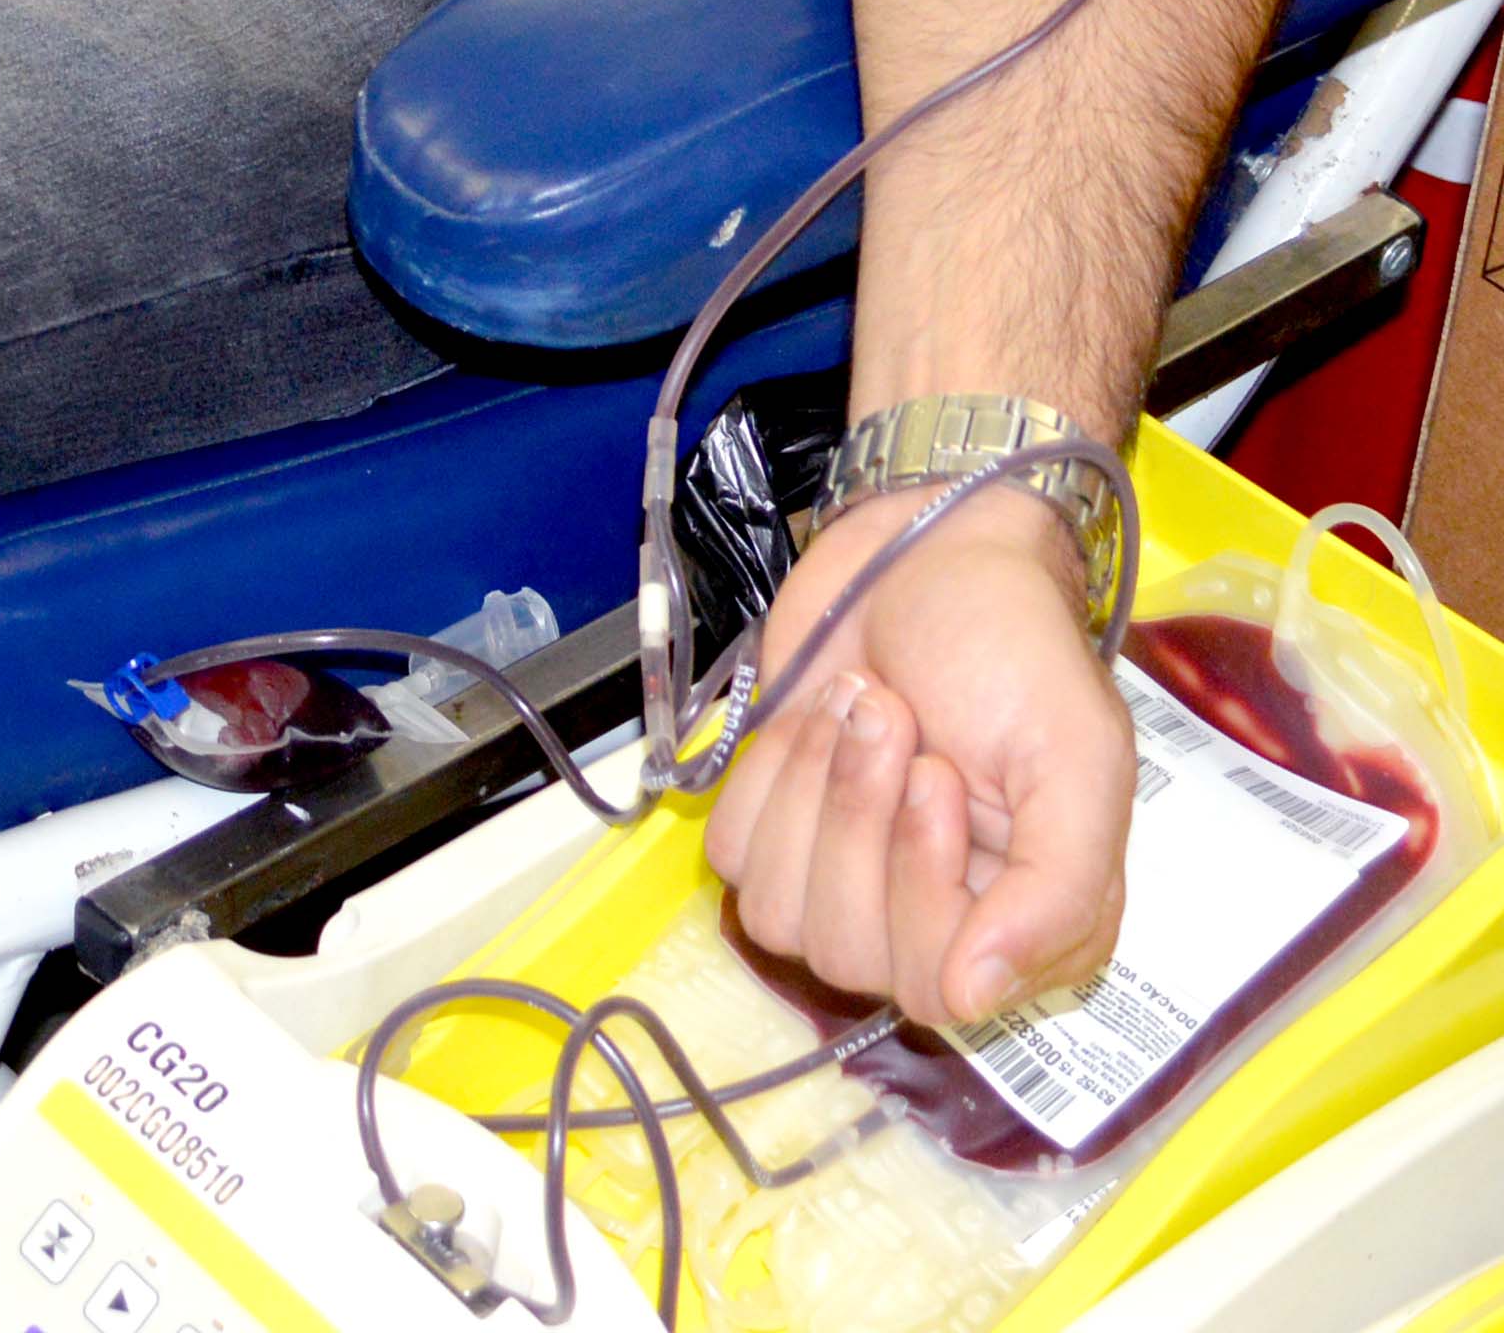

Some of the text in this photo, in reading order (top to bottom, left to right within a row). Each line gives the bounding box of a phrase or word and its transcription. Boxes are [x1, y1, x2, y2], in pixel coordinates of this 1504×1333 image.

[1136, 978, 1198, 1031] DOAÇÃO
[126, 1020, 230, 1114] CG20
[997, 1007, 1063, 1068] 008322
